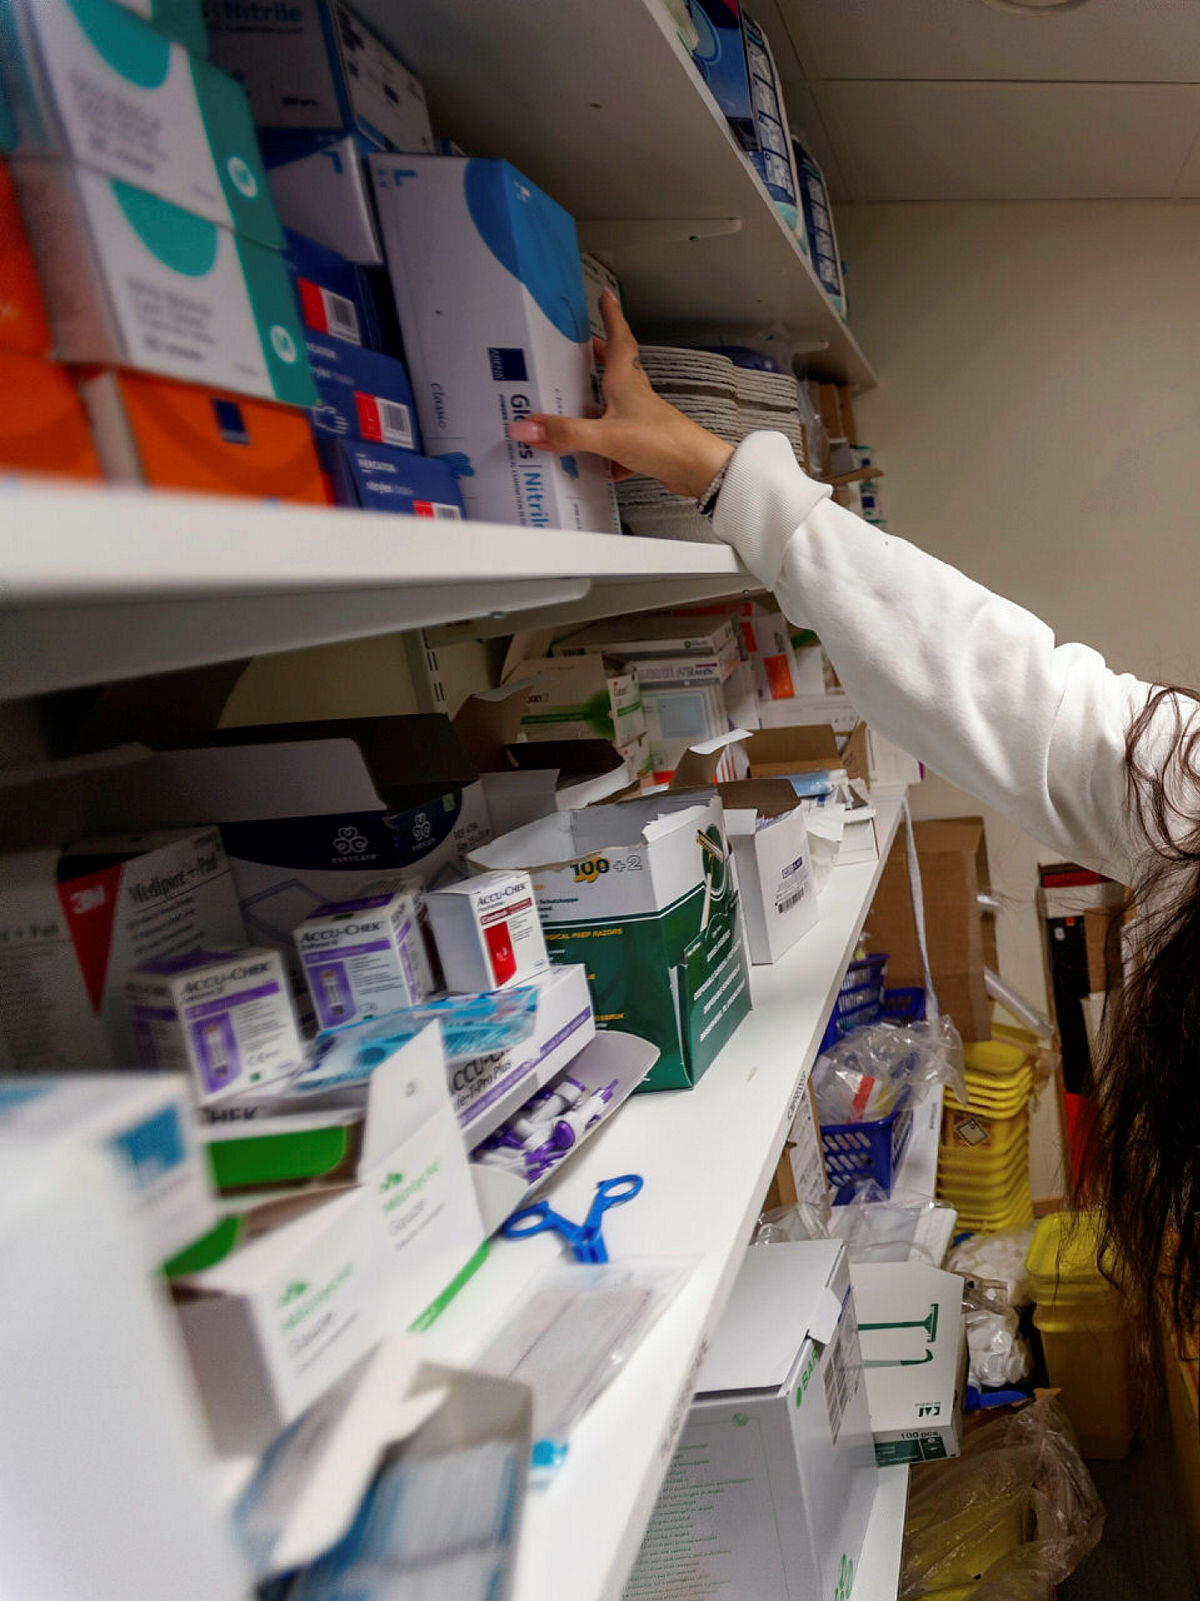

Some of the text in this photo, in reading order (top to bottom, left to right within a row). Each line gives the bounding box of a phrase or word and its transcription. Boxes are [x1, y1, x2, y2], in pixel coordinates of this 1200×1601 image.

[510, 393, 535, 460] Gloes
[69, 885, 106, 915] 3M
[478, 885, 527, 906] ACCU-CHEK
[301, 921, 381, 943] ACCU-CHEK
[183, 962, 269, 993] ACCU-CHEK
[203, 1106, 258, 1124] HEK
[900, 1431, 920, 1441] 100
